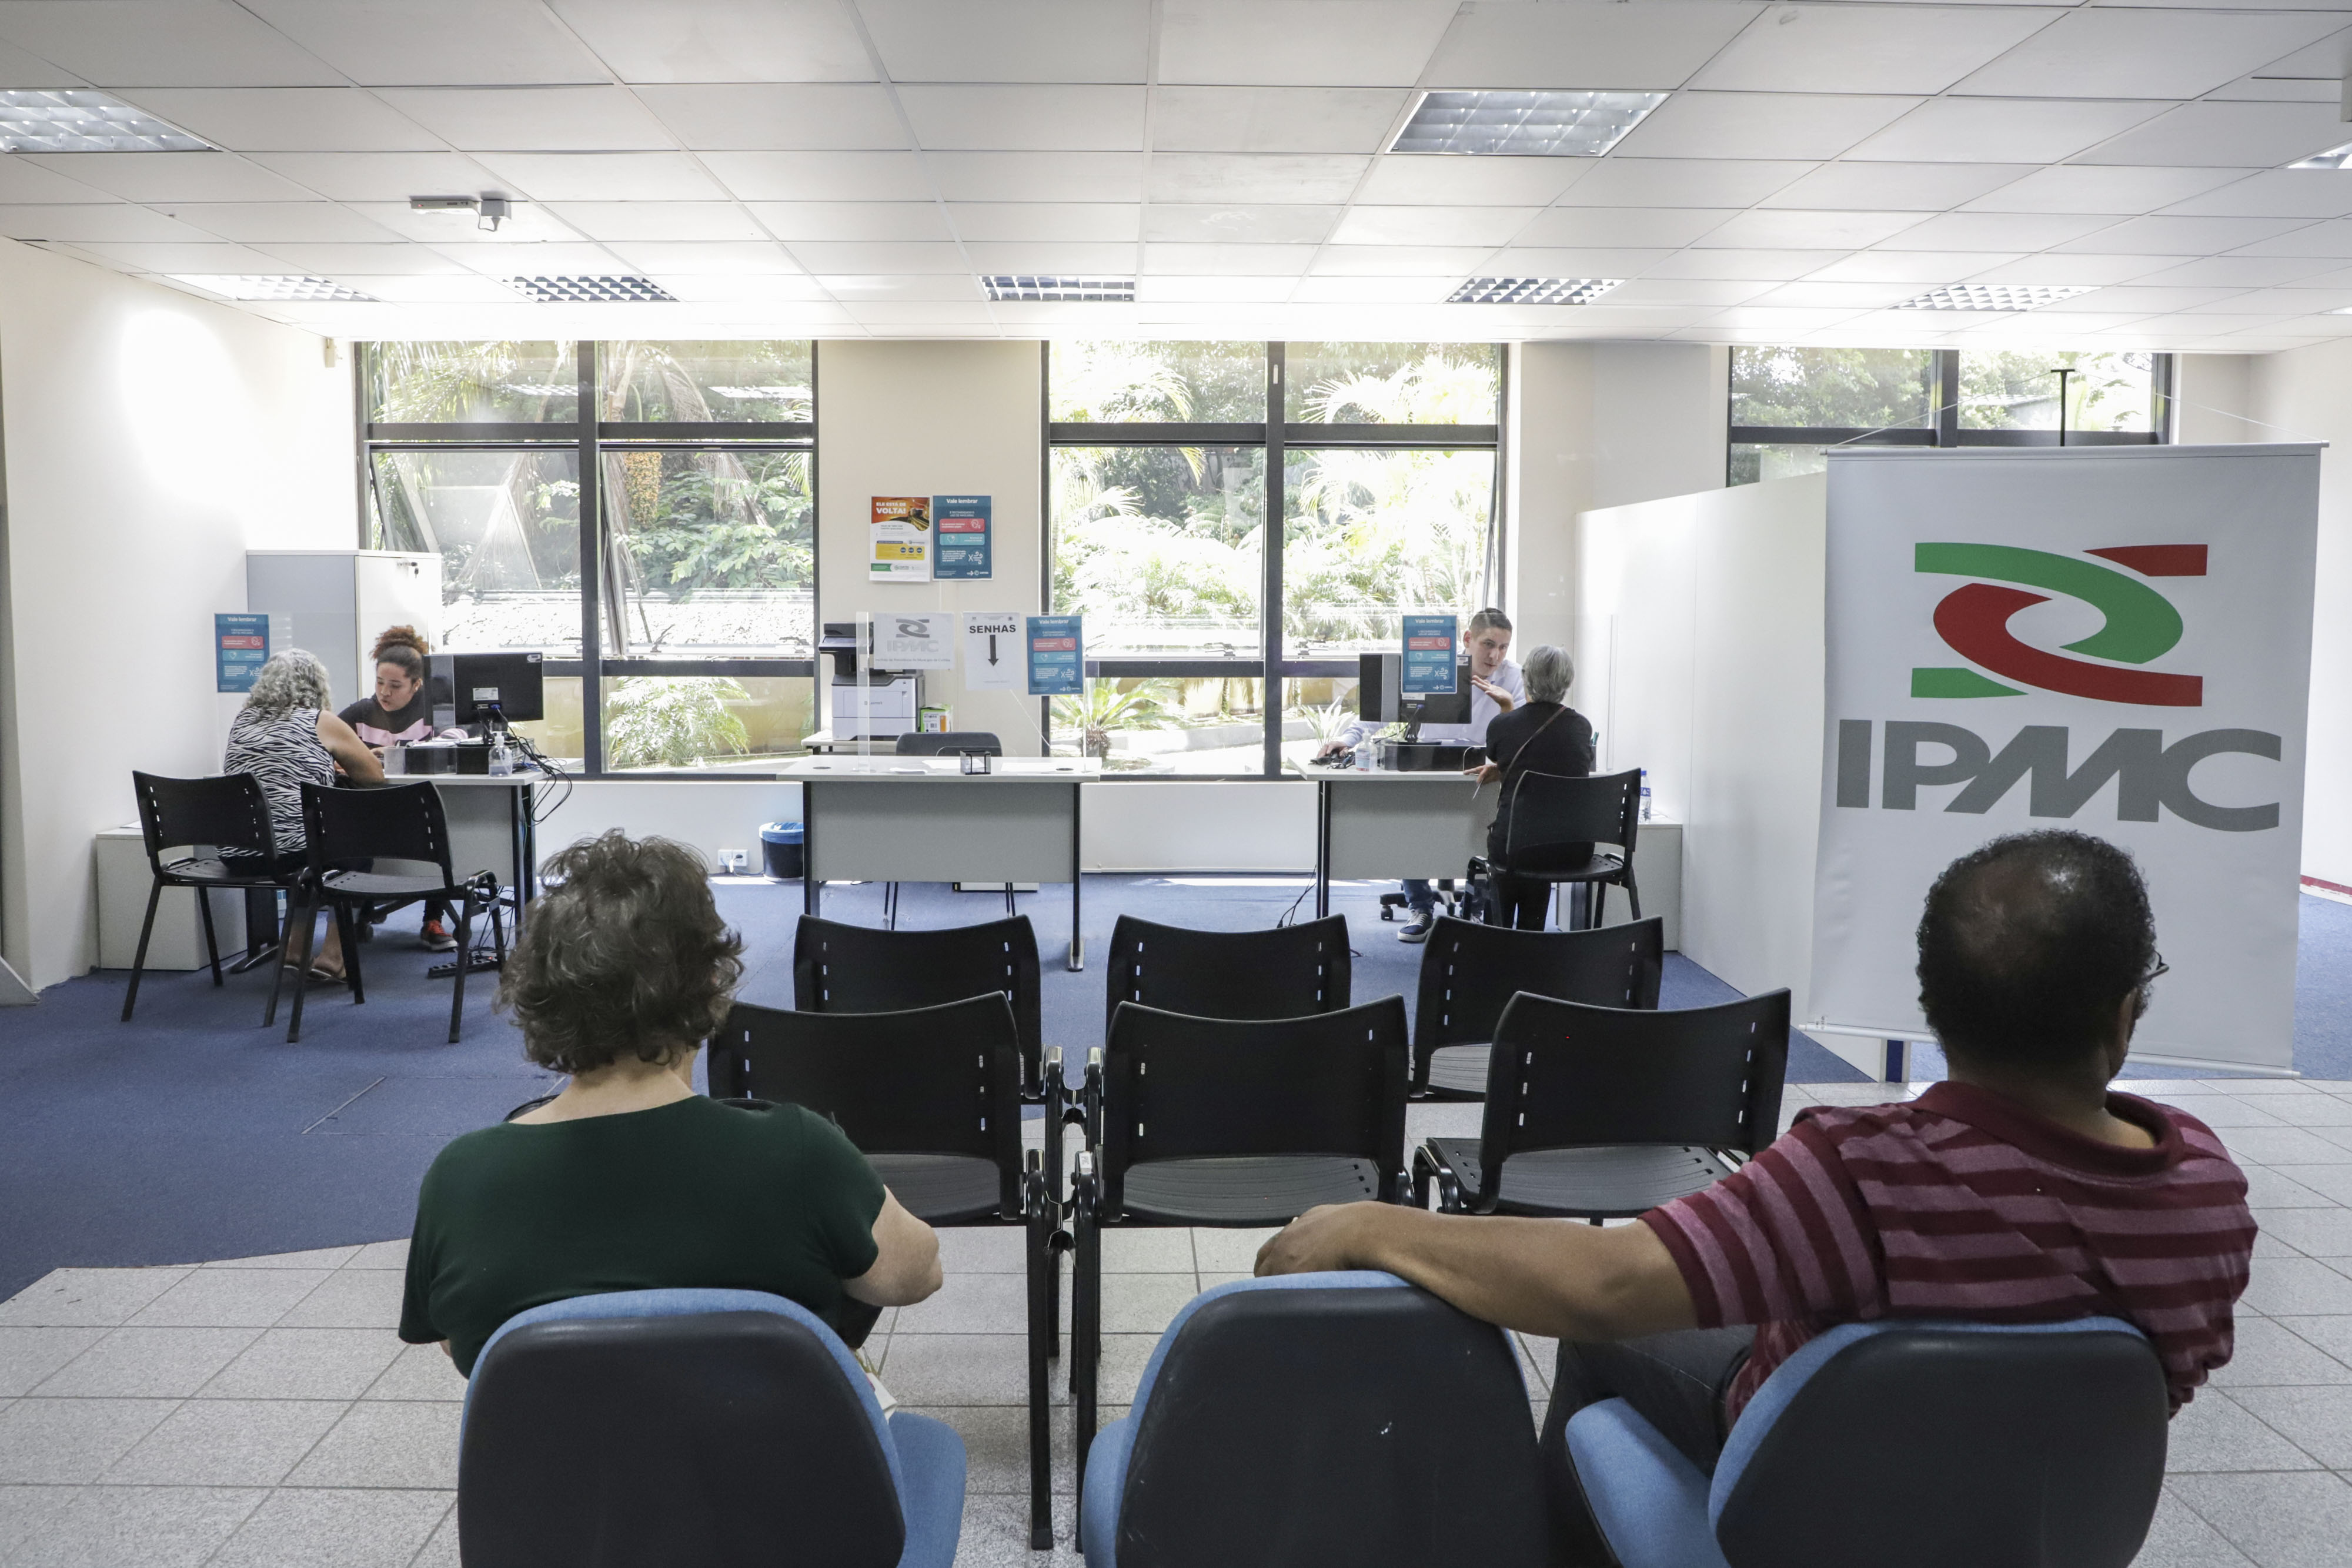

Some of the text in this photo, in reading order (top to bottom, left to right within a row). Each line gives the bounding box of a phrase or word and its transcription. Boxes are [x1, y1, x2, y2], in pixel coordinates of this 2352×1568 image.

[969, 624, 1016, 633] SENHAS
[887, 640, 938, 652] IPMC
[1836, 719, 2282, 832] IPMC
